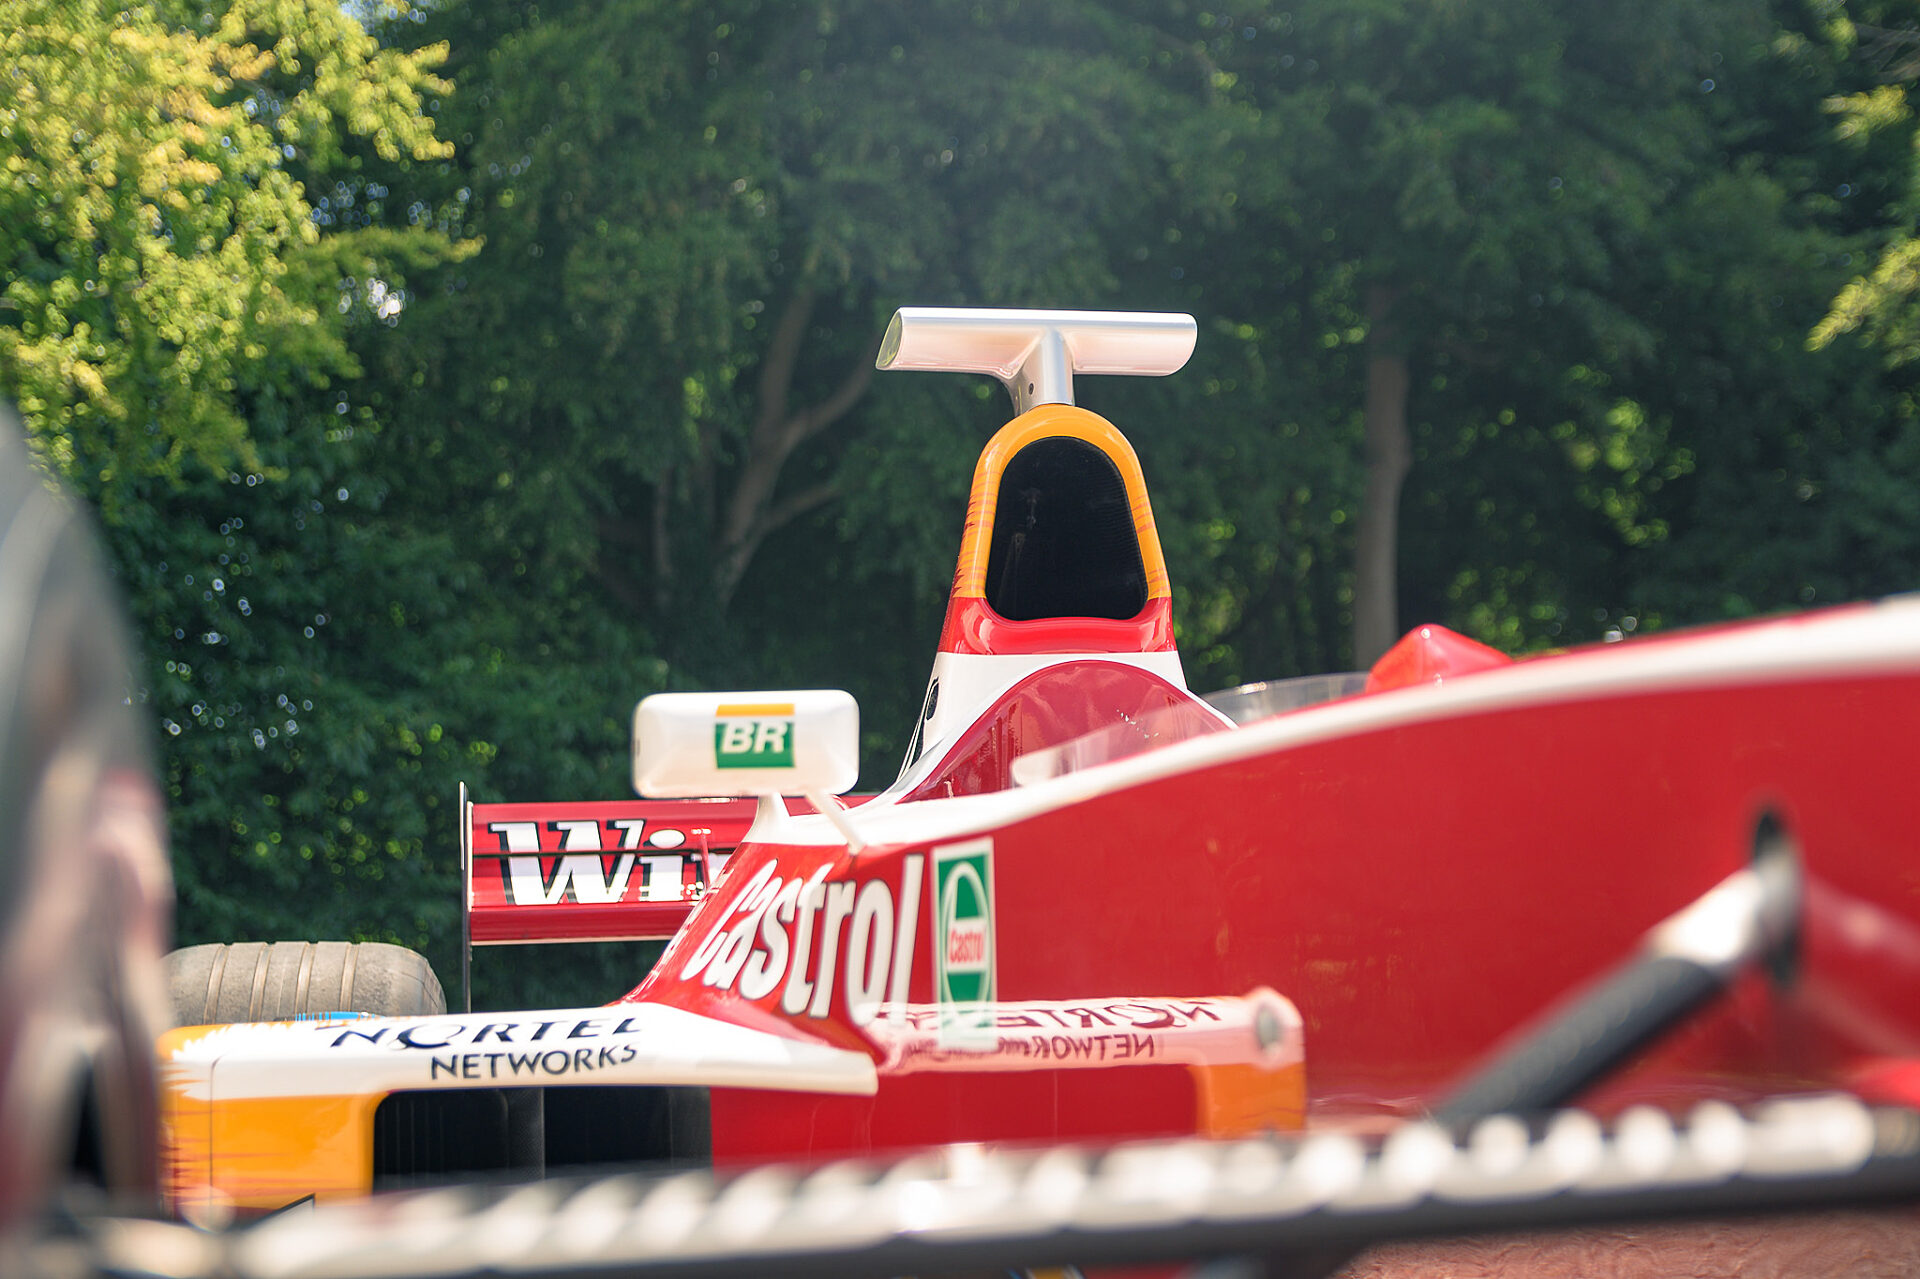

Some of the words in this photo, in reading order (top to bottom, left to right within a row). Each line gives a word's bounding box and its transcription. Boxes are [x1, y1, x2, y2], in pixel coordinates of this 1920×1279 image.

[721, 720, 789, 754] BR
[679, 853, 925, 1028] Castrol
[949, 926, 985, 964] Castrol
[330, 1017, 642, 1051] NORTEL
[430, 1042, 638, 1081] NETWORKS
